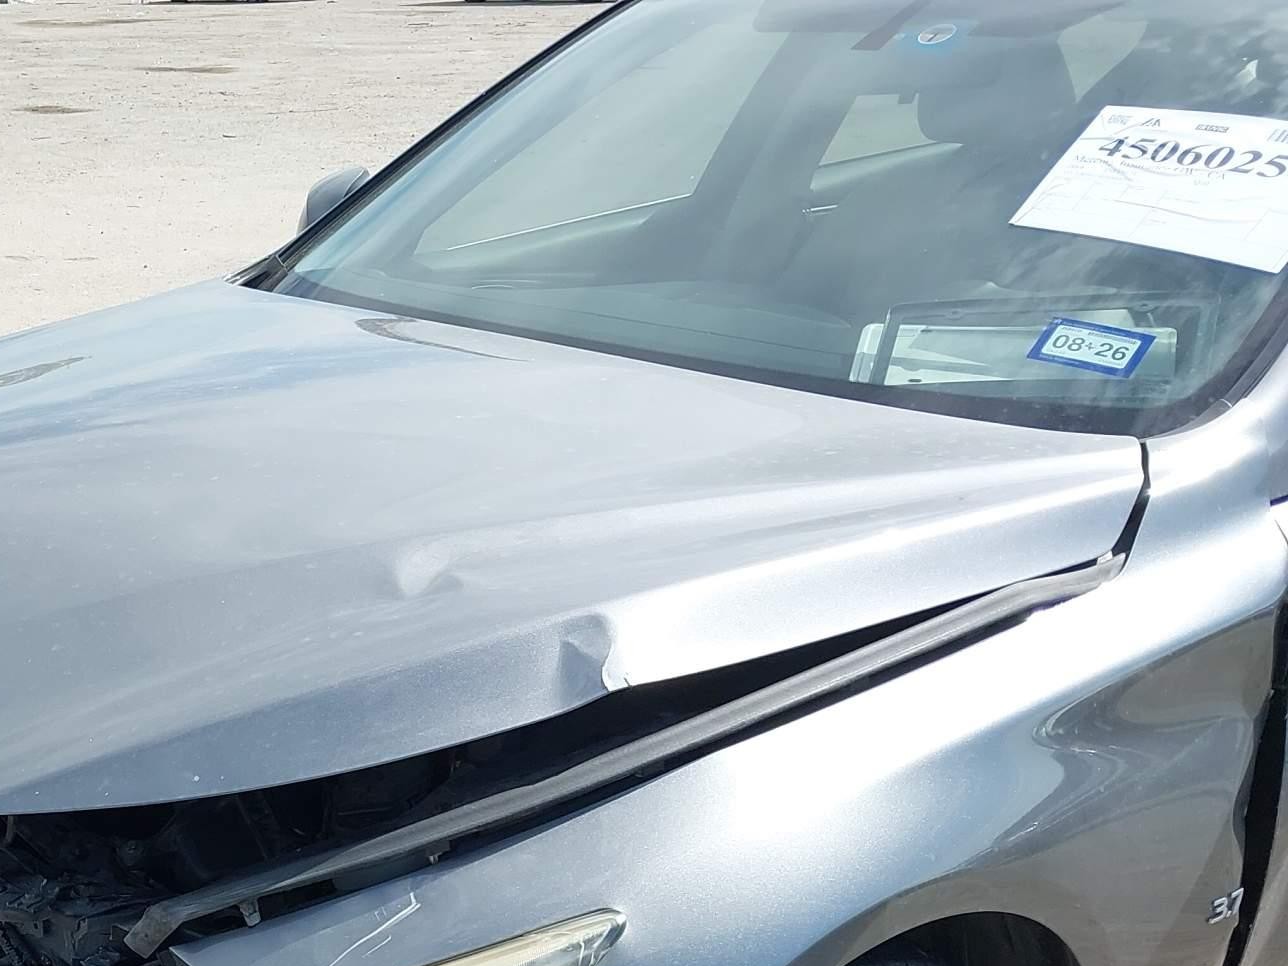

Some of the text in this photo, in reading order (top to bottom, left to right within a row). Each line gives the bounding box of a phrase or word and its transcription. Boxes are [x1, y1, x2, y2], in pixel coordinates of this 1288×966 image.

[1098, 135, 1288, 178] 4506025
[1052, 334, 1086, 352] 08
[1094, 342, 1130, 361] 26
[1208, 887, 1244, 924] 3.7
